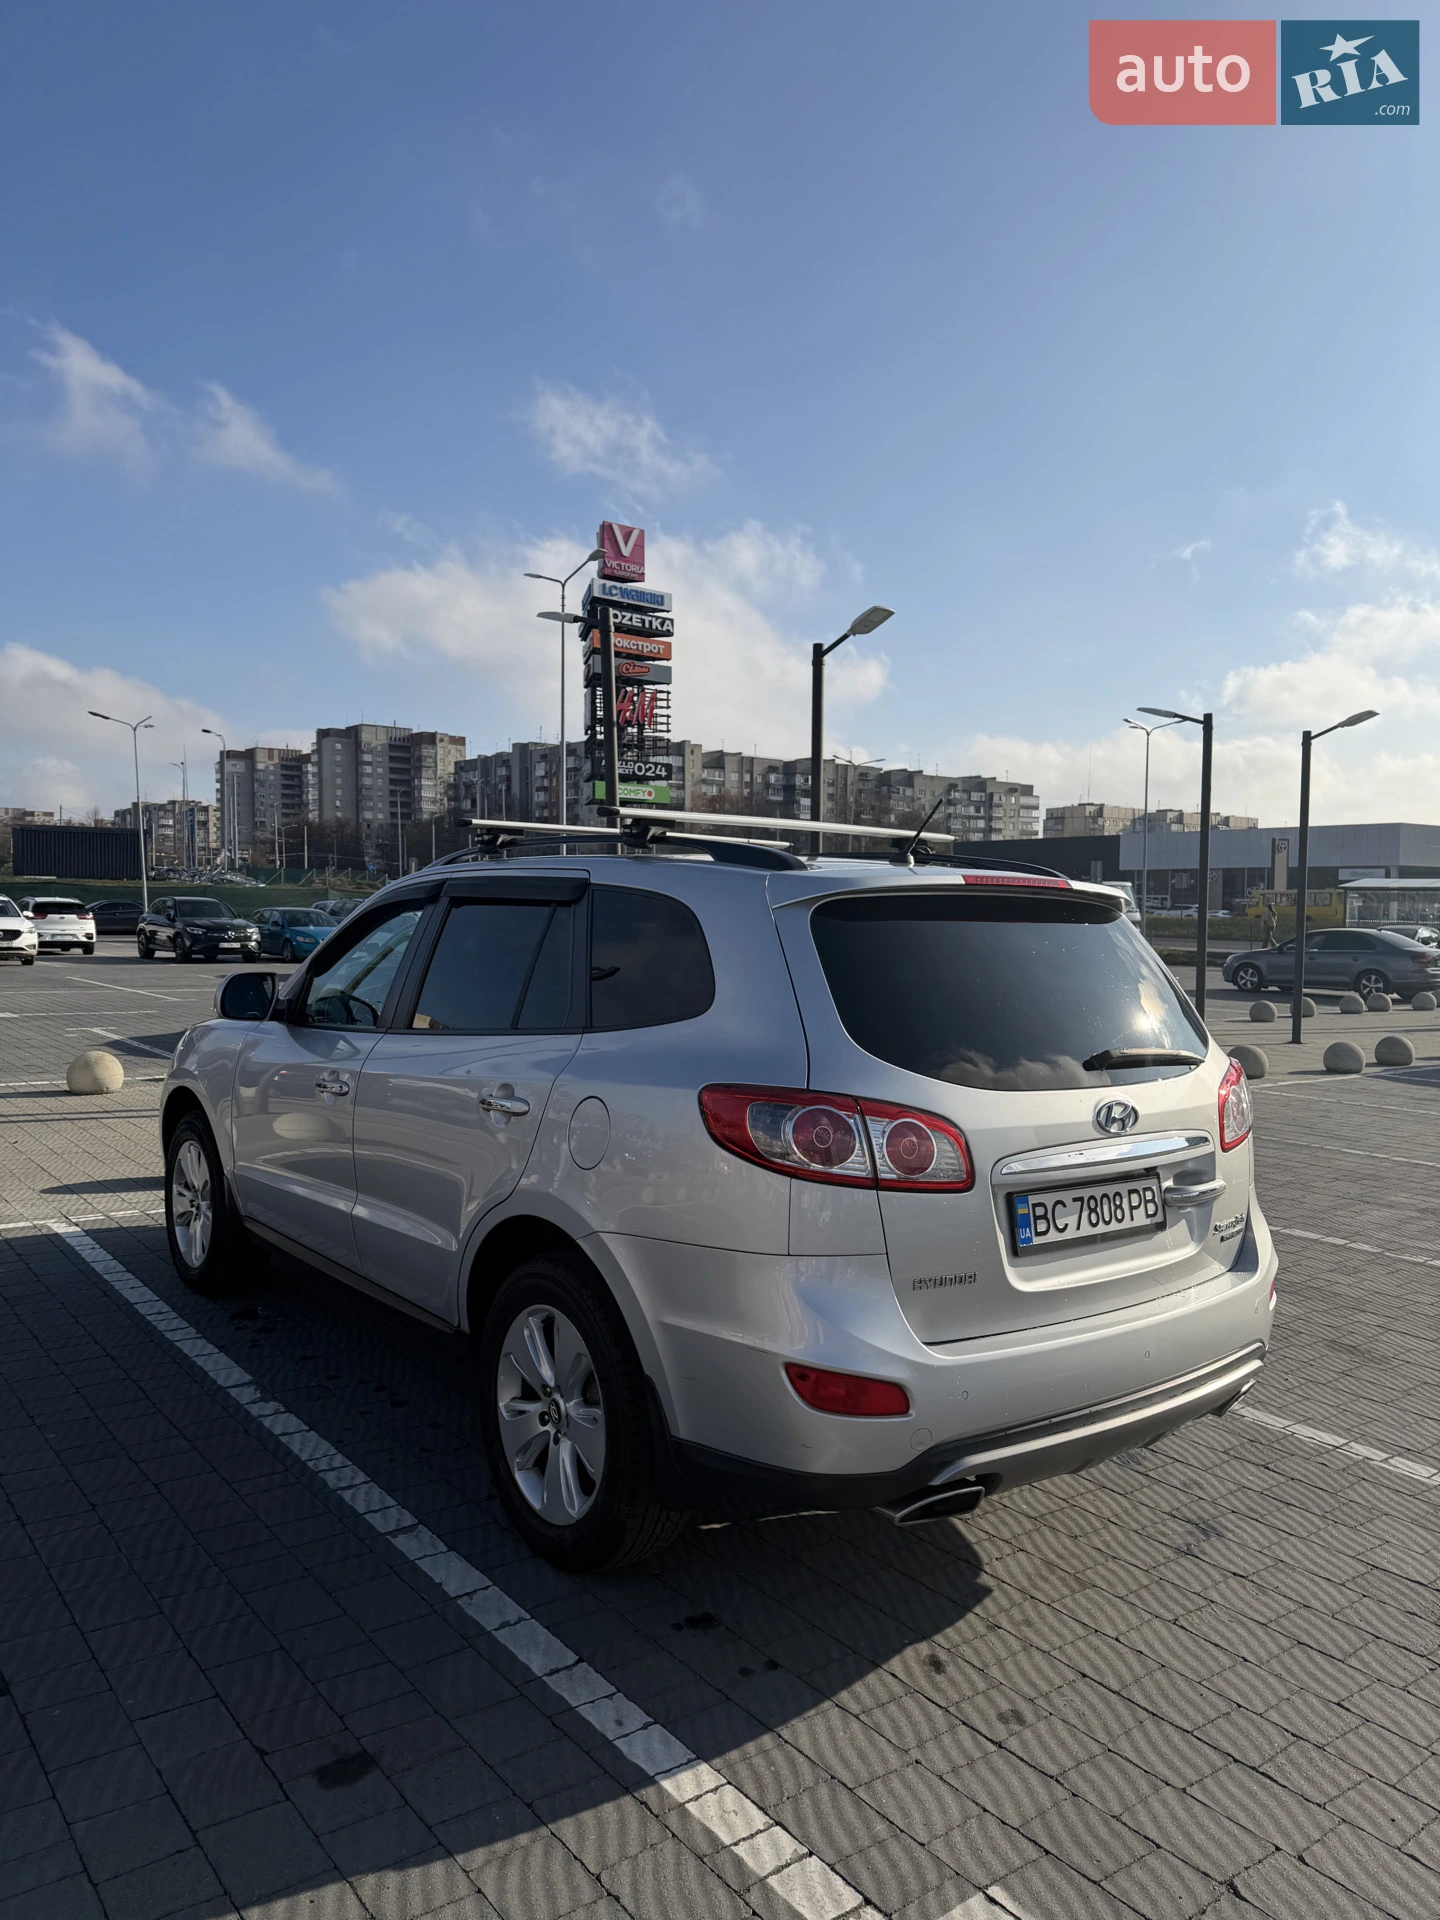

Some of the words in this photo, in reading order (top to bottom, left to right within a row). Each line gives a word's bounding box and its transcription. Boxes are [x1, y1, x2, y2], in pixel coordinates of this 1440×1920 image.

[611, 523, 640, 557] V
[605, 559, 645, 574] VICTORIA
[598, 607, 673, 633] OZETKA
[1020, 1227, 1032, 1239] UA
